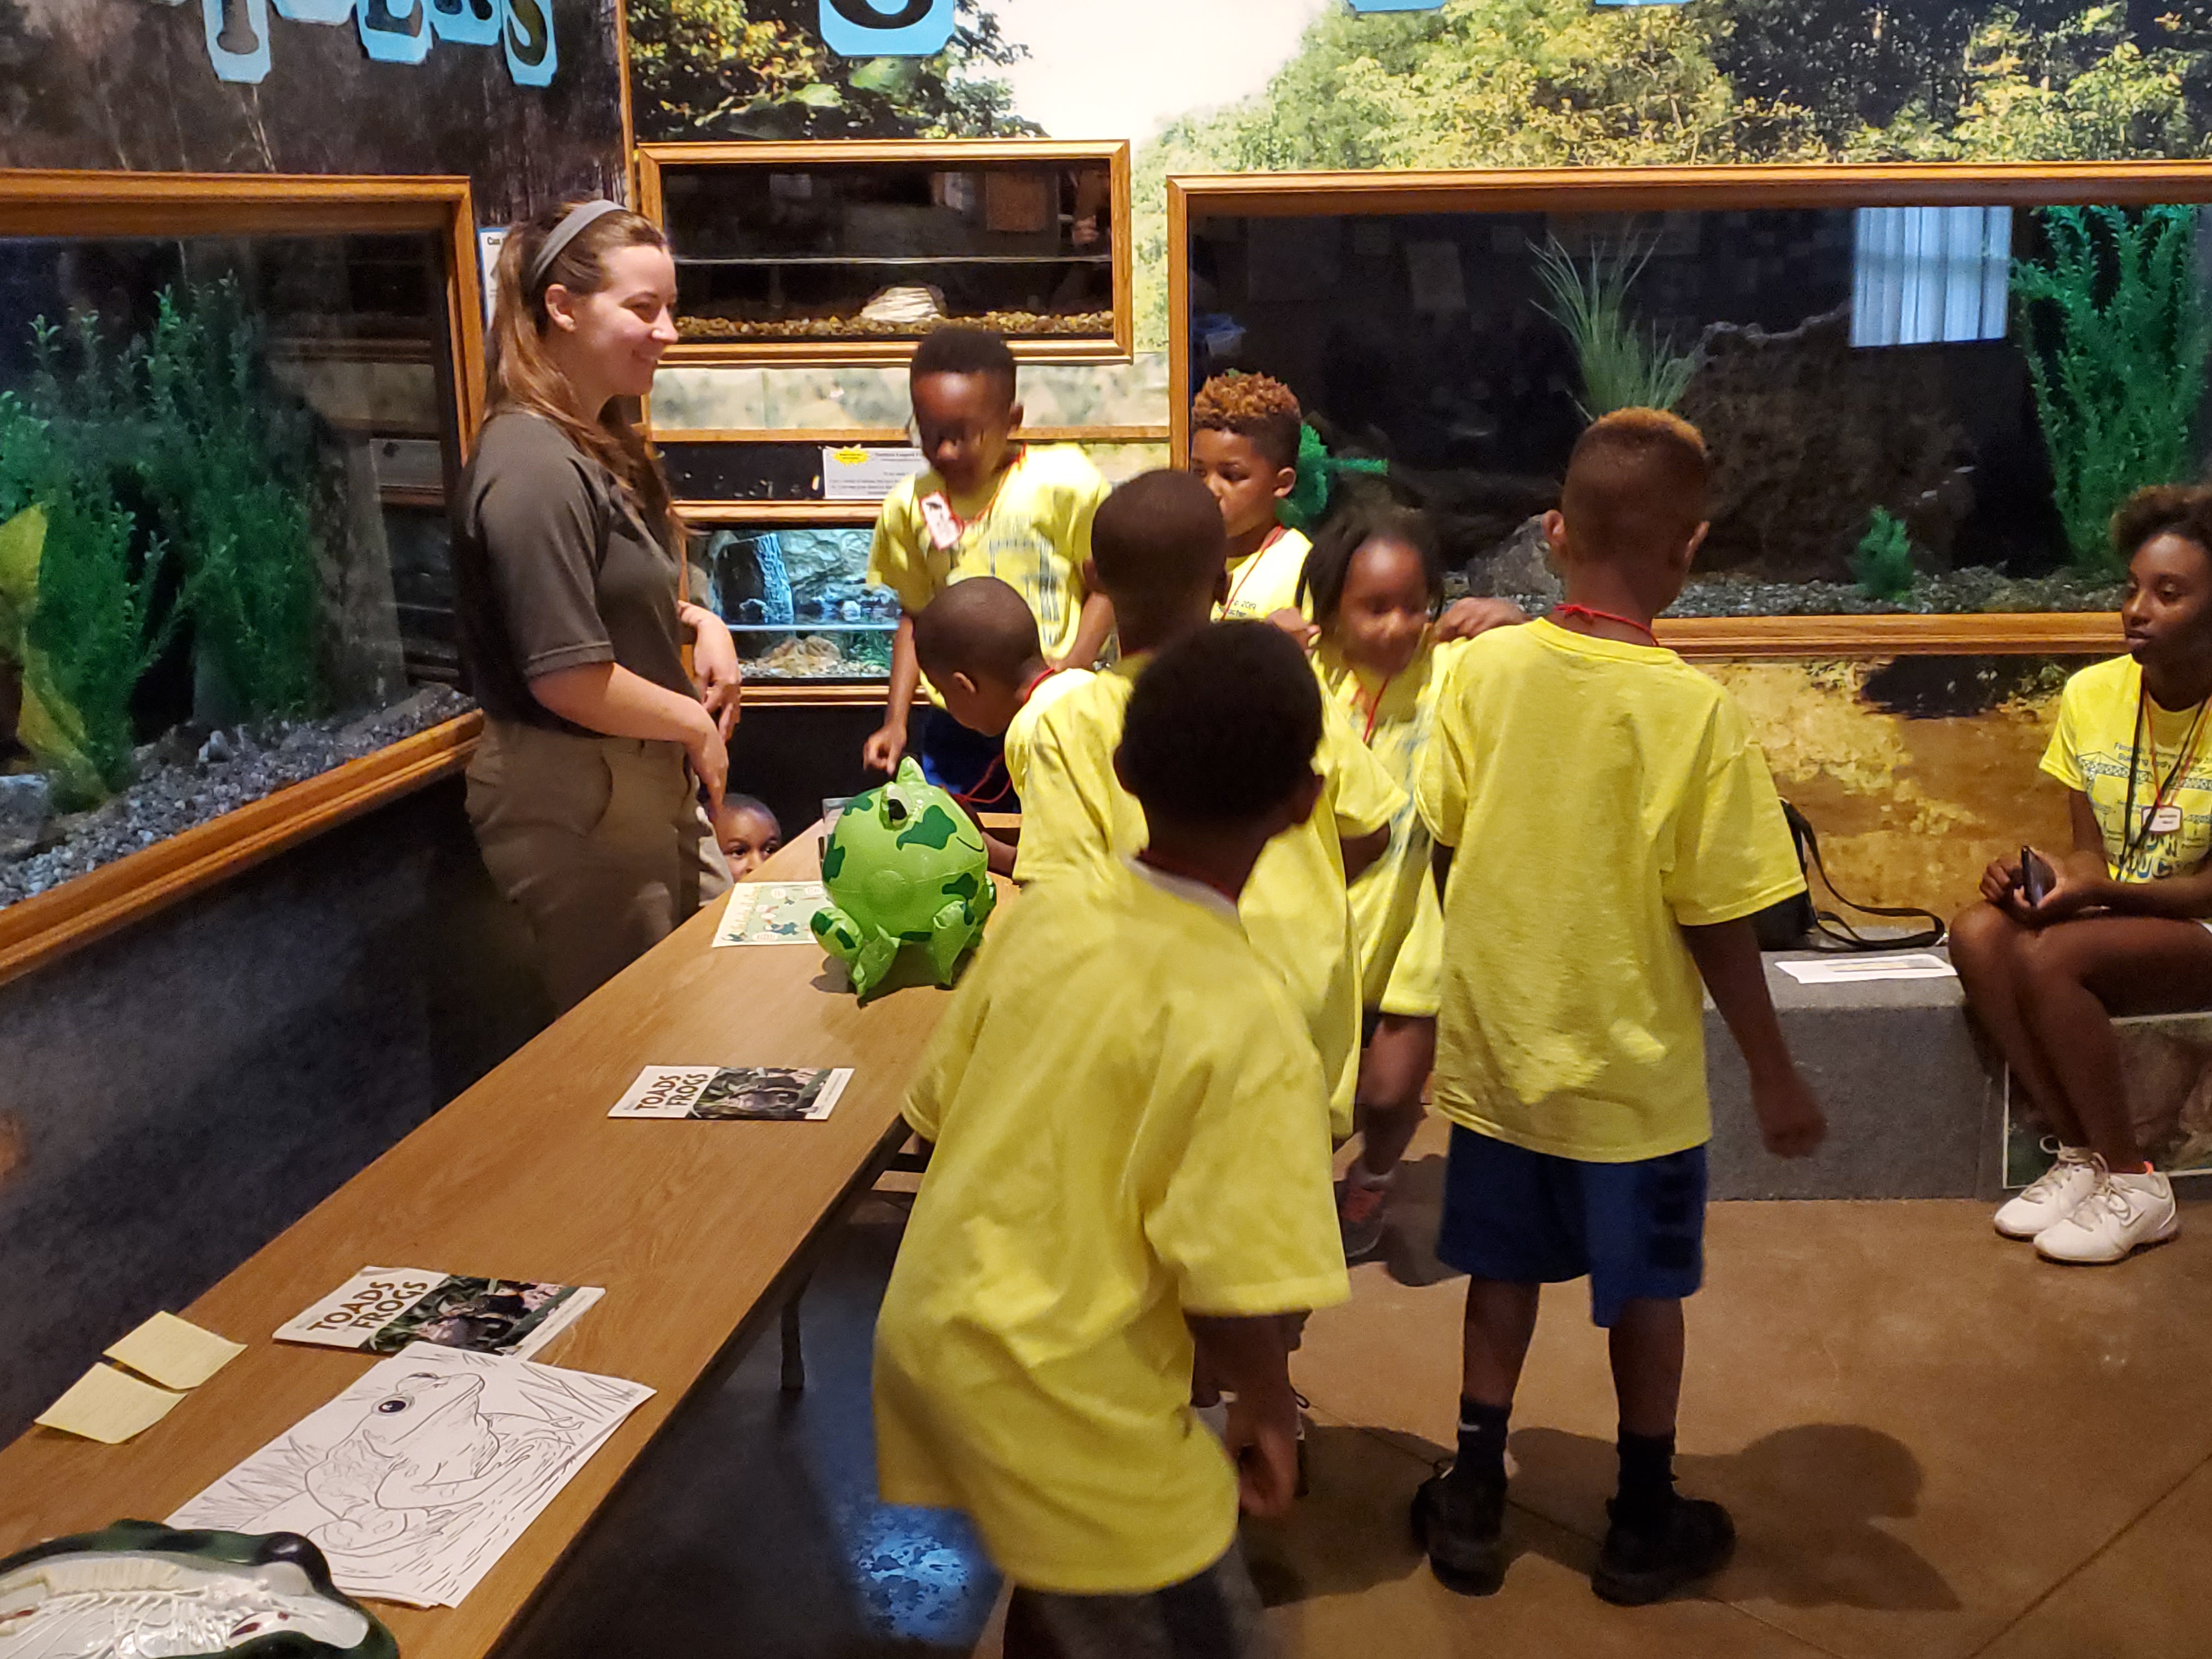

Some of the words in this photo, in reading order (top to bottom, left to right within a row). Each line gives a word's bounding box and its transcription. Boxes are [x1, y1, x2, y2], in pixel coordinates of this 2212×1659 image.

[633, 1075, 681, 1110] TOADS
[665, 1074, 708, 1105] FROGS
[307, 1282, 394, 1330] TOADS
[348, 1282, 427, 1328] FROGS
